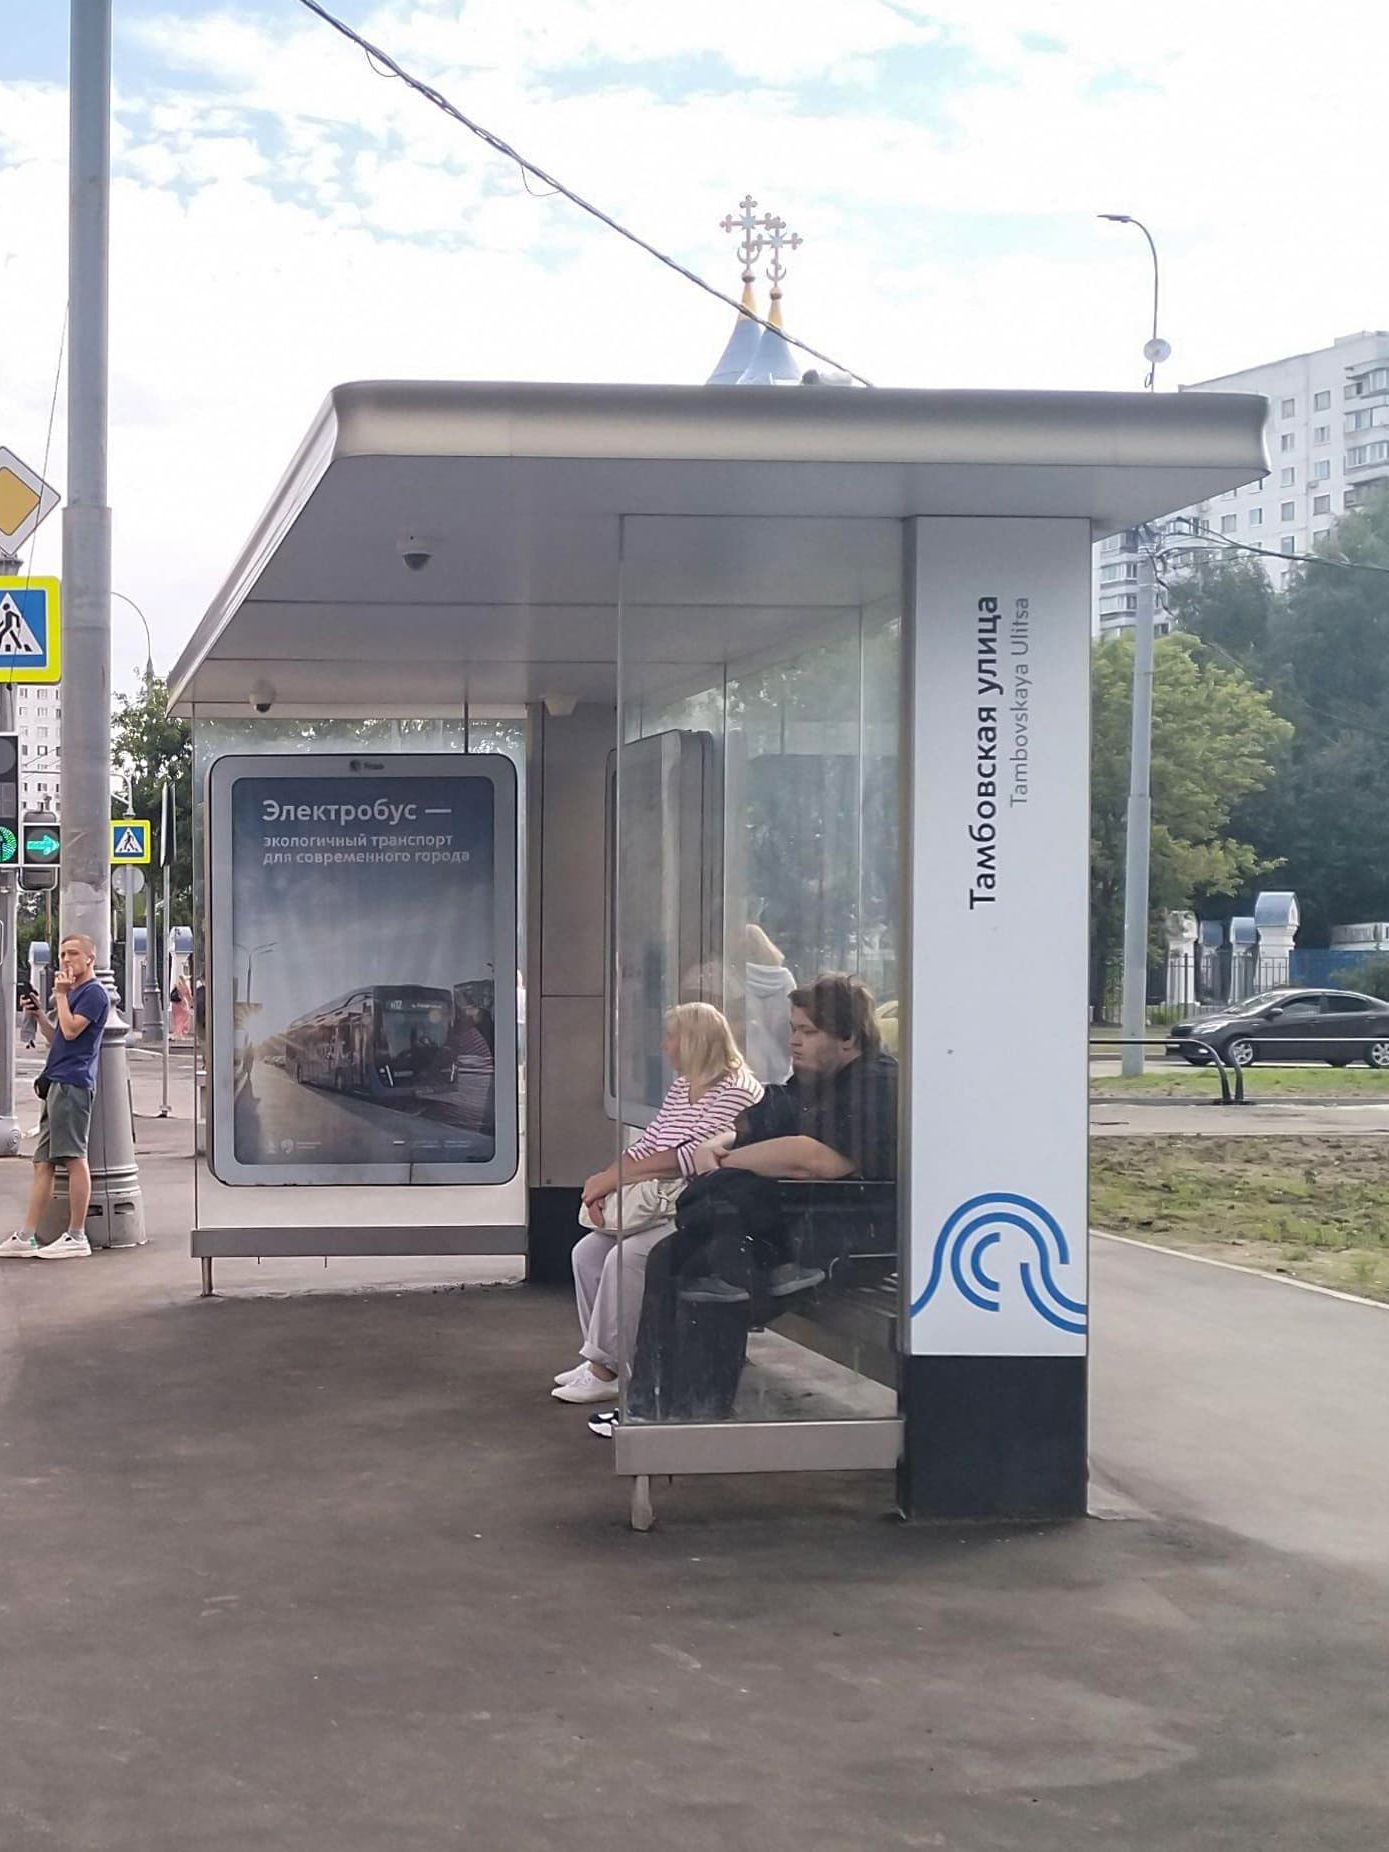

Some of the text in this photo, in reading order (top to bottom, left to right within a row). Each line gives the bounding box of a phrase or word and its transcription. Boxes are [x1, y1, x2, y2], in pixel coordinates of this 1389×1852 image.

[1010, 597, 1032, 807] Tambovskaya Ulitsa
[969, 597, 1003, 909] Тамбовская улица
[262, 799, 417, 825] Электробус
[263, 834, 453, 848] экологичный транспорт
[263, 851, 470, 865] для современного города
